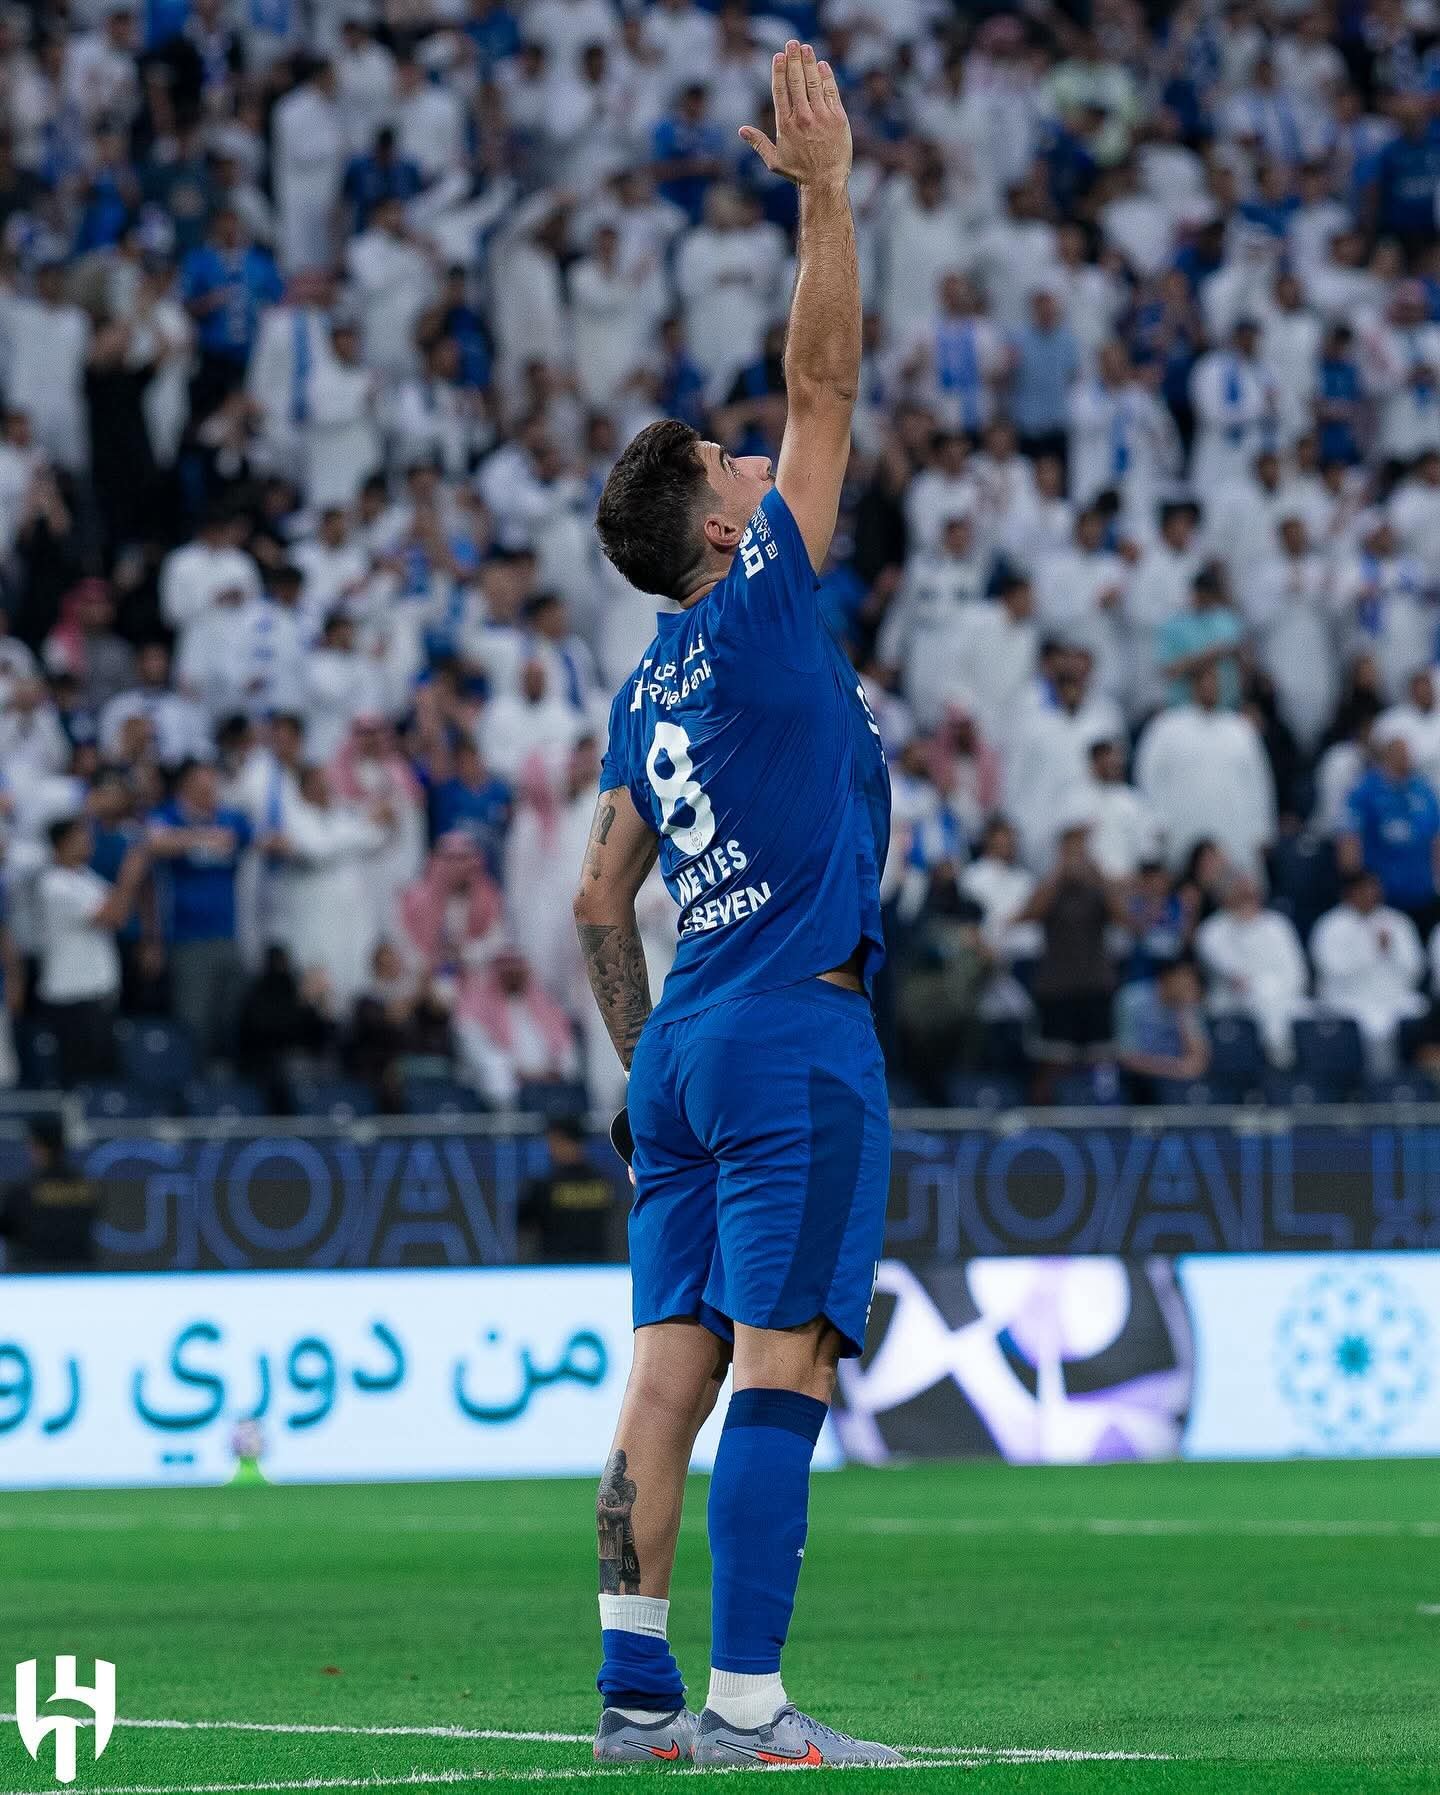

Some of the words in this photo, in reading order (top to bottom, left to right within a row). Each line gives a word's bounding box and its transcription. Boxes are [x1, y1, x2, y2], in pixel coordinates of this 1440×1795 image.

[645, 721, 716, 856] 8
[675, 839, 748, 908] NEVES
[132, 1322, 406, 1464] دوري
[454, 1330, 608, 1424] من
